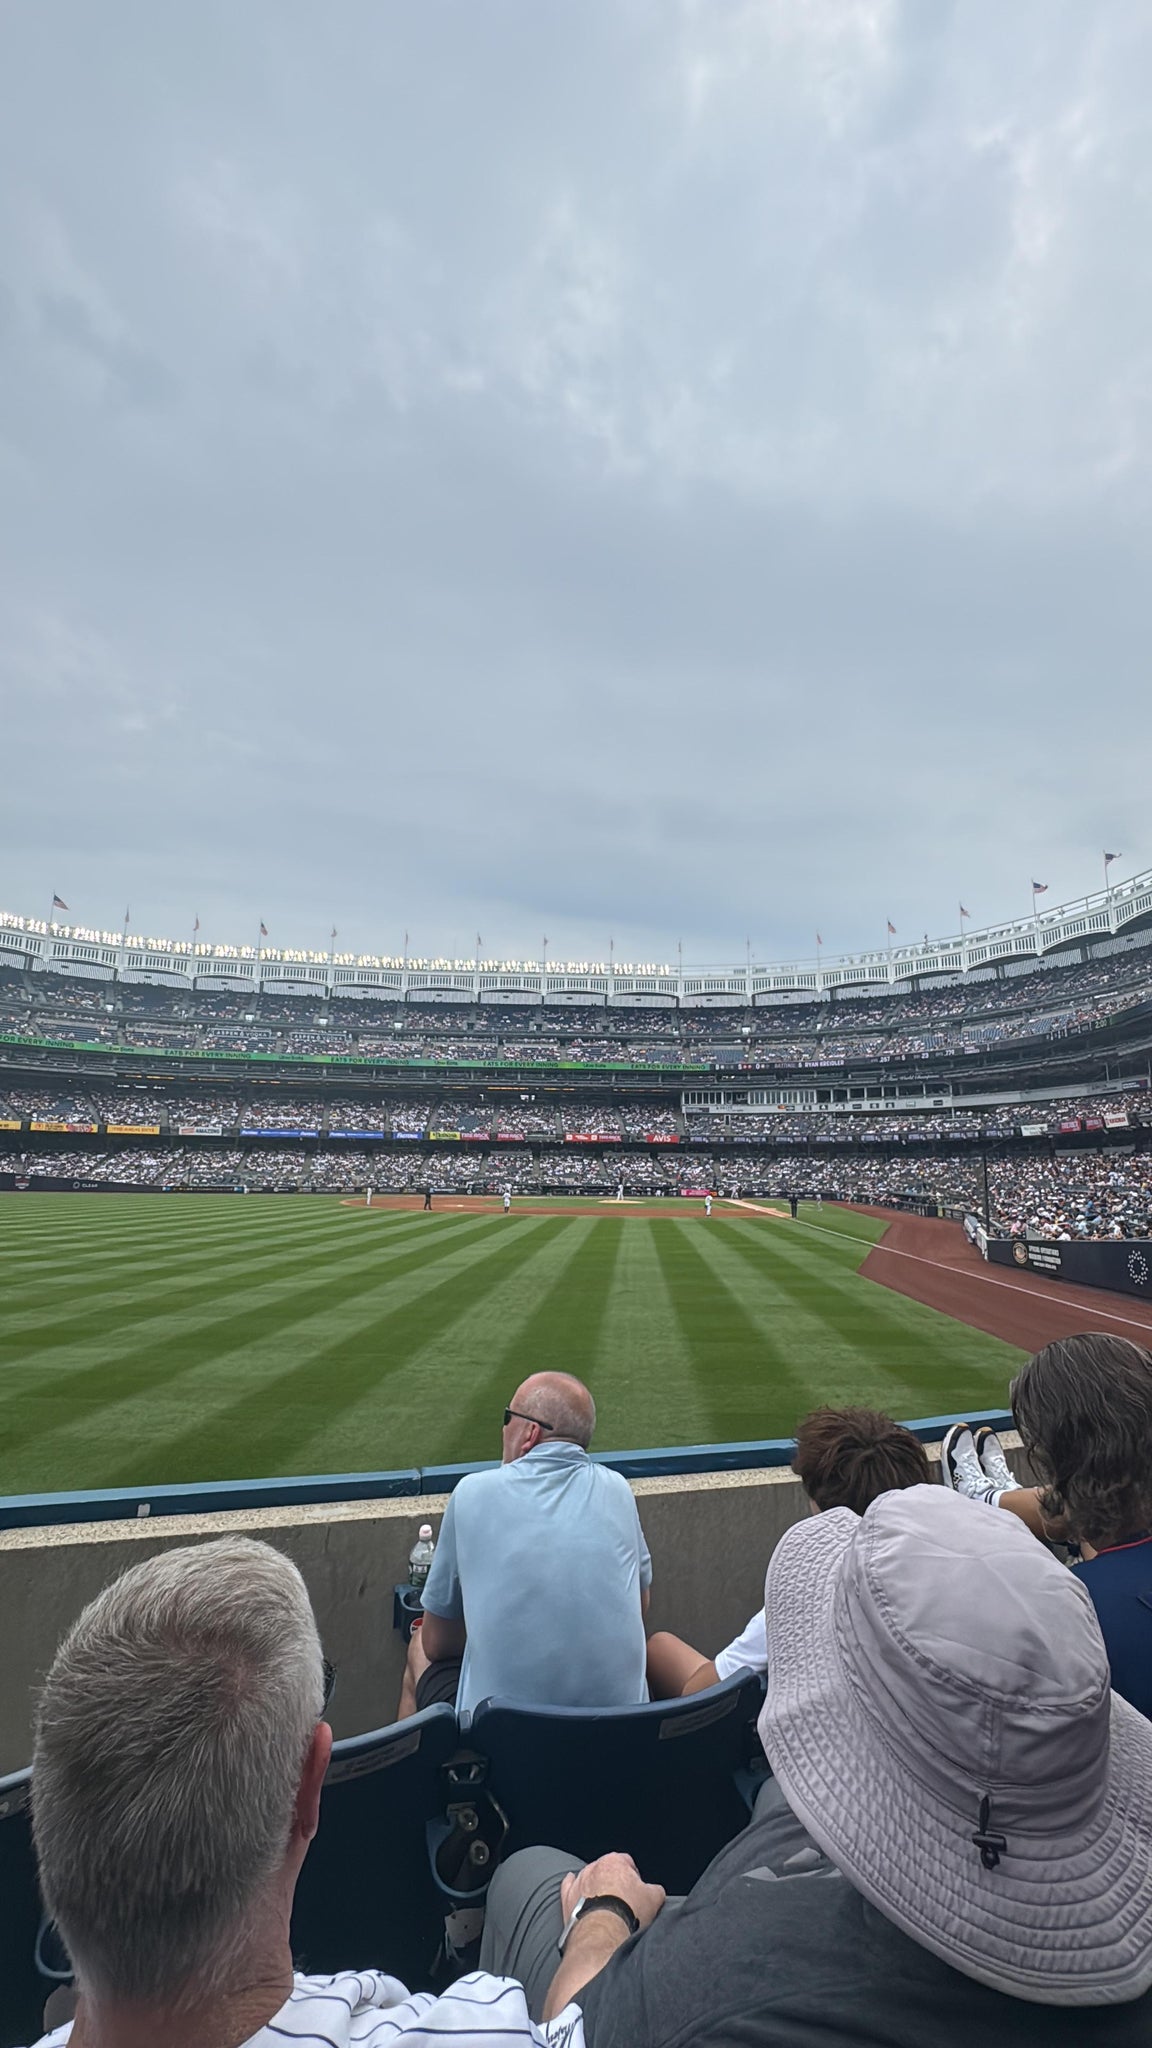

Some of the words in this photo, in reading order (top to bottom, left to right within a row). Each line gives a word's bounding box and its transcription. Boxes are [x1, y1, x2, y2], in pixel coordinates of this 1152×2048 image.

[17, 1036, 43, 1045] EVERY
[45, 1041, 75, 1049] INNING
[164, 1049, 183, 1057] EATS
[653, 1134, 671, 1142] AVIS
